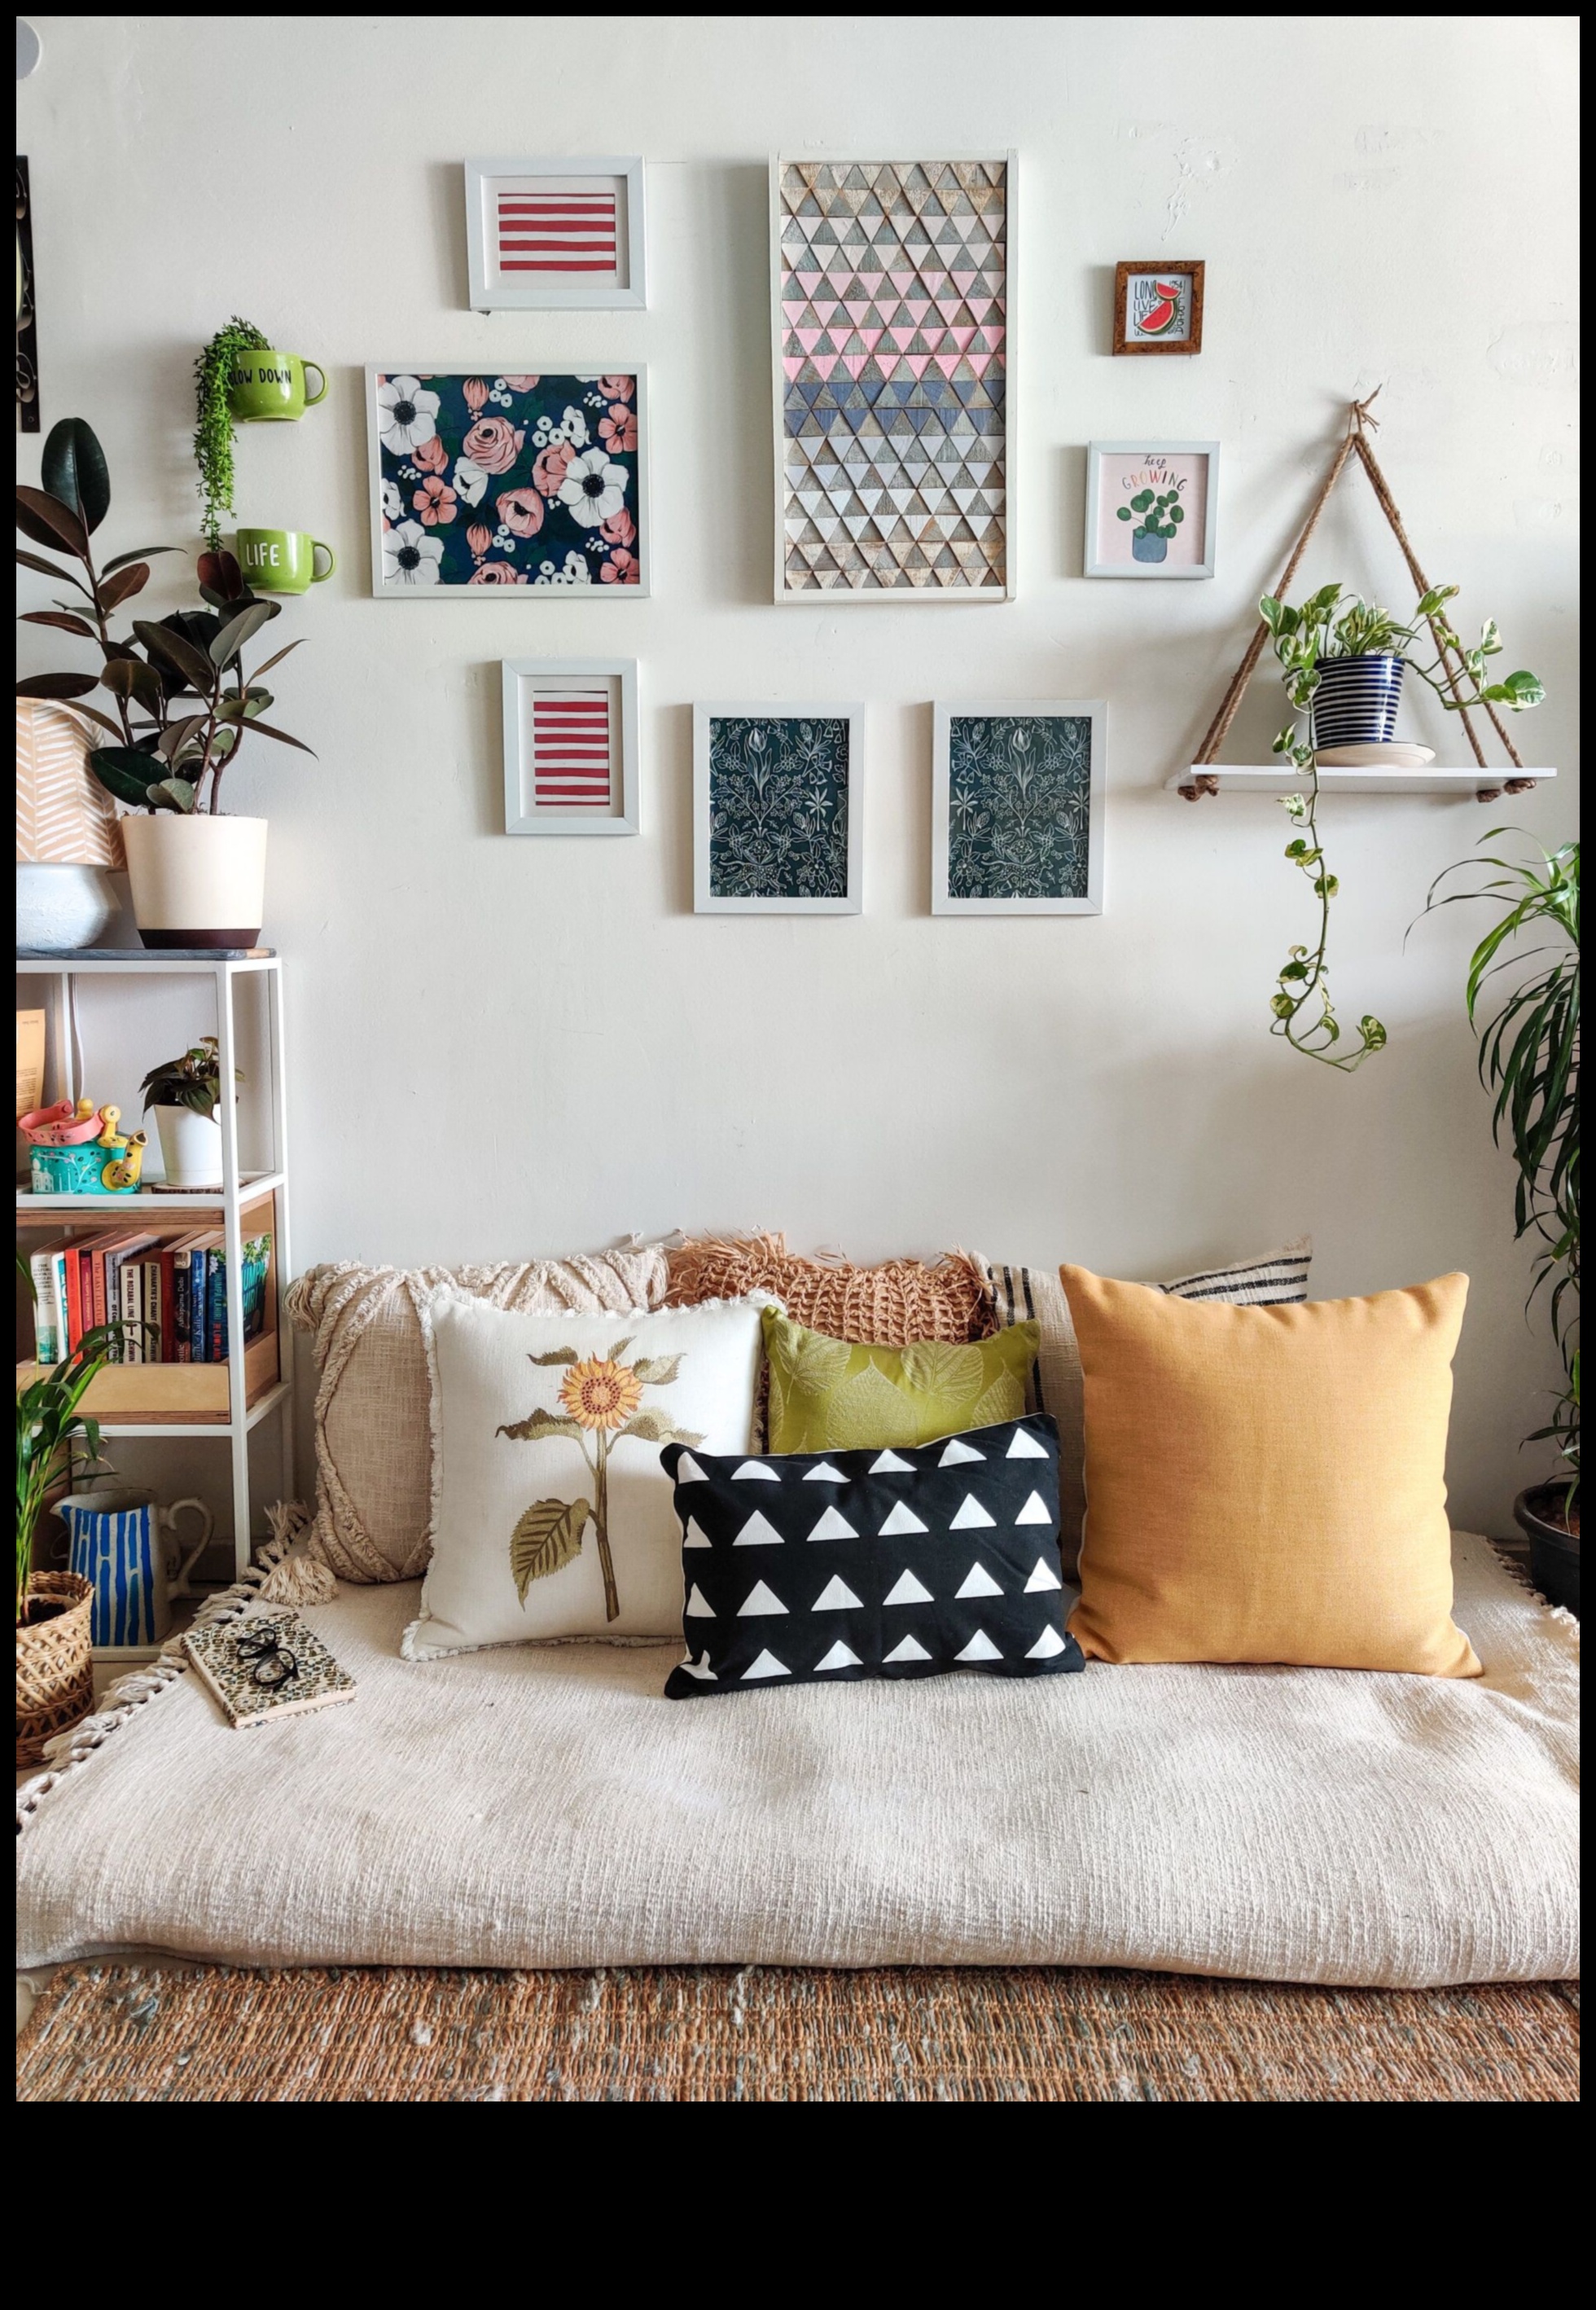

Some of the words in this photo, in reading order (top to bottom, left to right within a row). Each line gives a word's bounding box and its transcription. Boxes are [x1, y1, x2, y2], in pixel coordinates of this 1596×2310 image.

[258, 367, 292, 384] DOWN
[1122, 469, 1187, 491] GROWING
[246, 542, 280, 567] LIFE
[126, 1268, 134, 1279] THE
[127, 1305, 135, 1318] LINE
[150, 1301, 158, 1321] CHANT
[213, 1298, 222, 1320] LAHIRI
